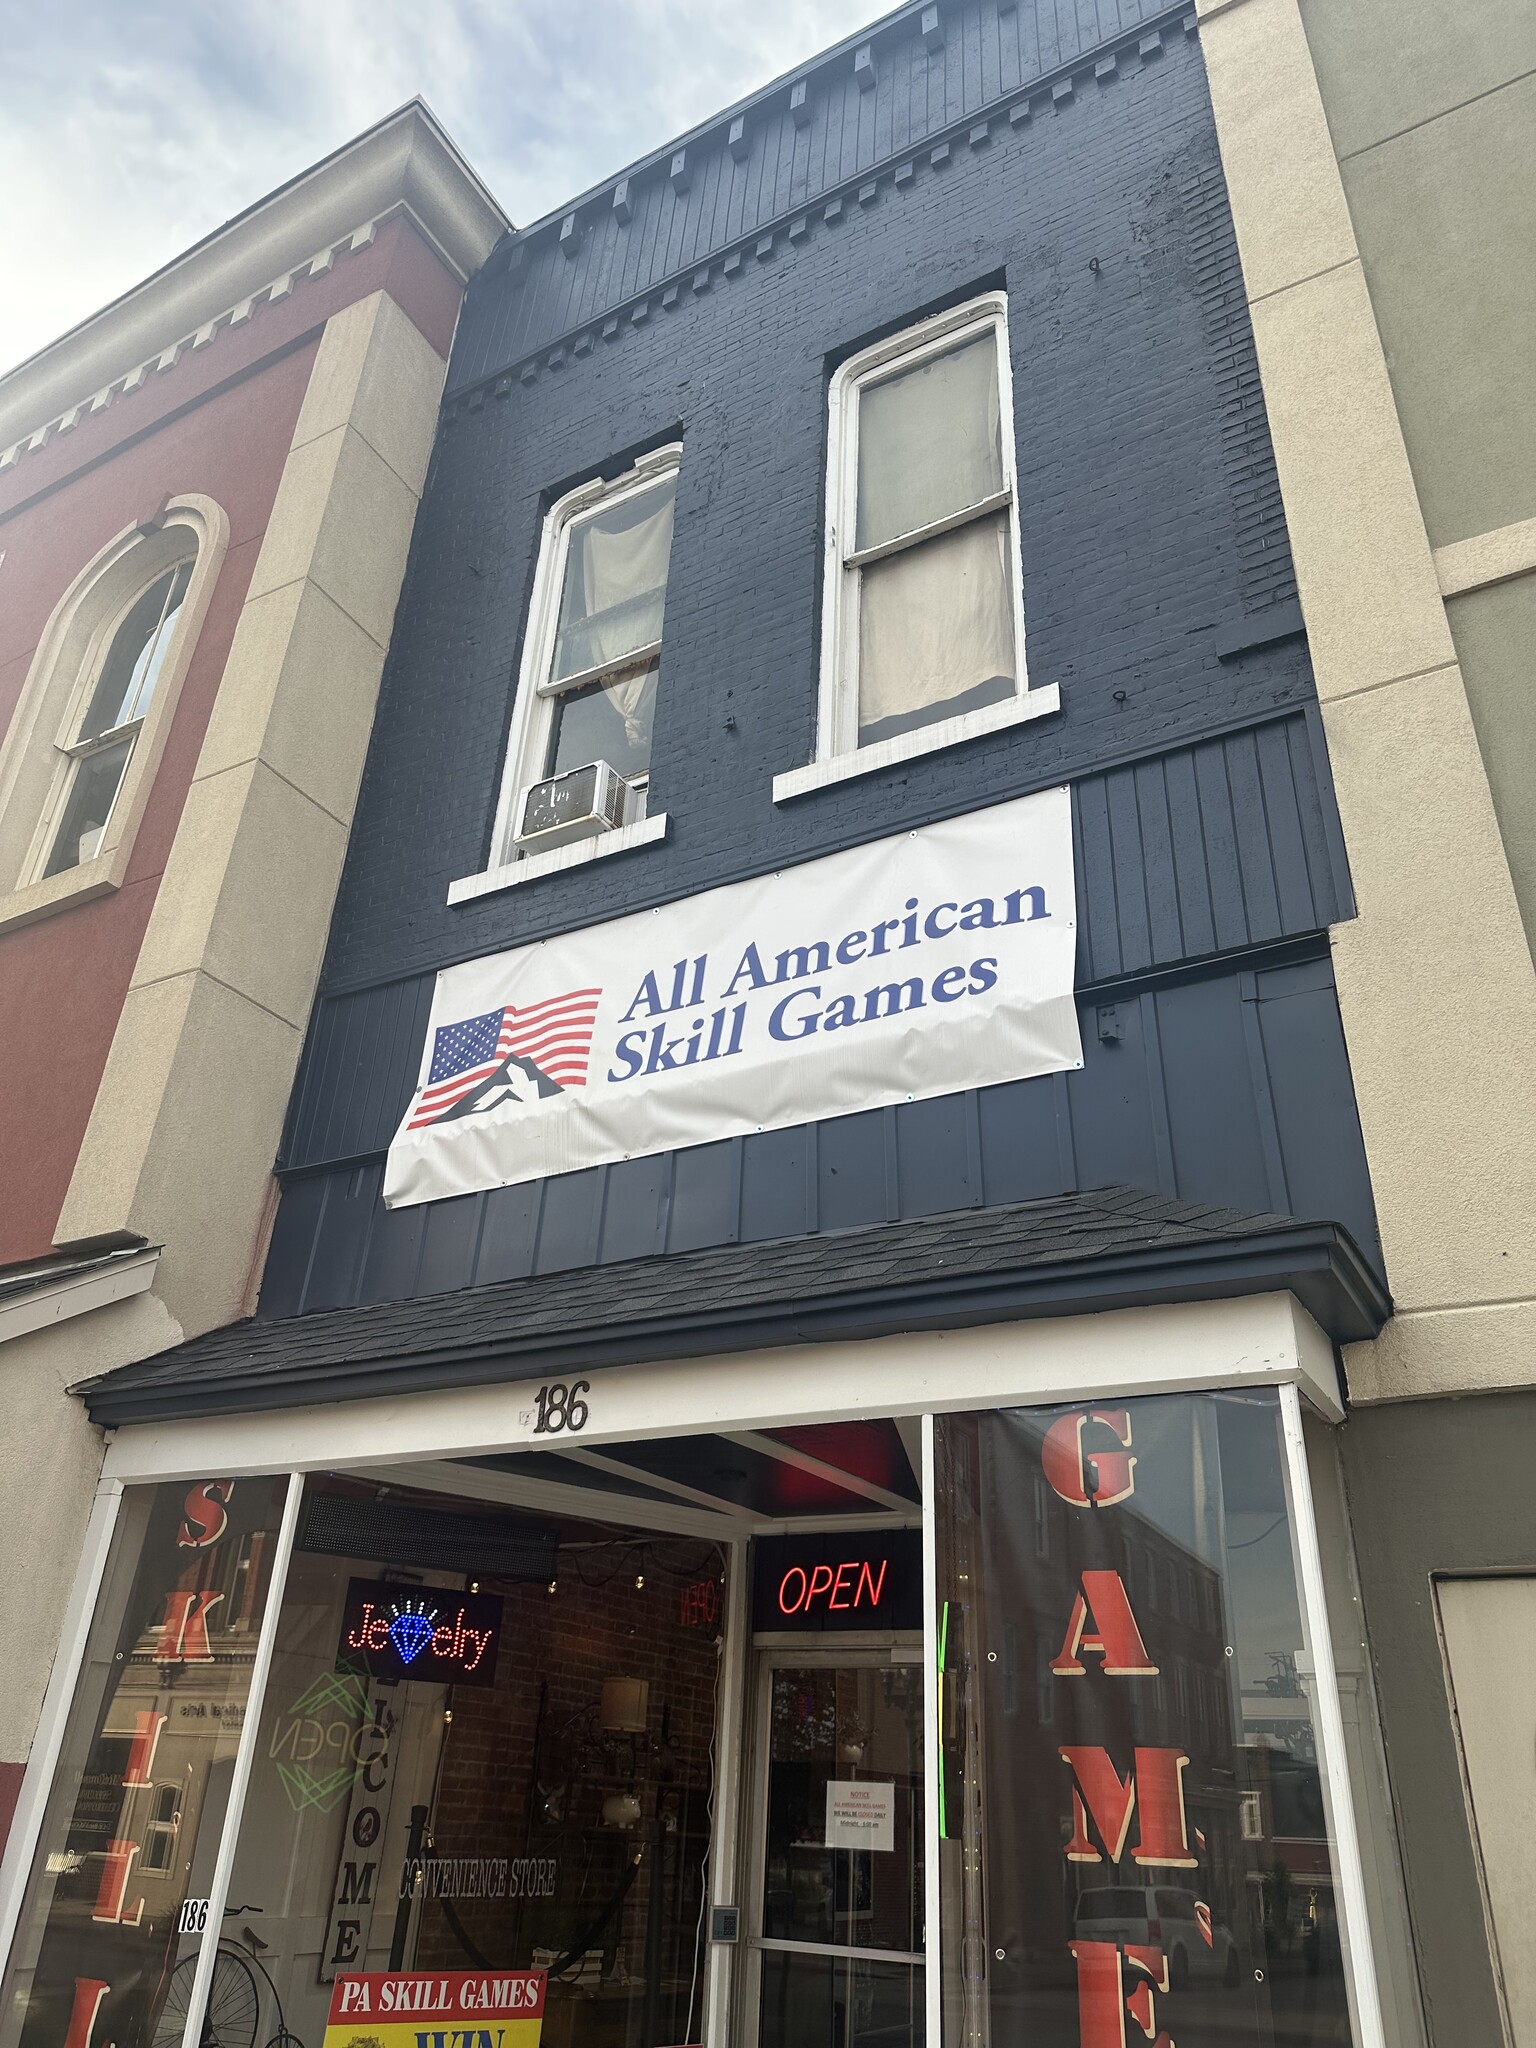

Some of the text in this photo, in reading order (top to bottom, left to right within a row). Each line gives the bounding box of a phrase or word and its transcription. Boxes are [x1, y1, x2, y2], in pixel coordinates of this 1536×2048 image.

[617, 885, 1052, 1024] All American
[607, 957, 999, 1083] Skill Games
[533, 1380, 590, 1433] 186
[779, 1560, 887, 1614] OPEN
[330, 1676, 400, 1964] LCOME
[850, 1791, 870, 1799] NOTICE
[399, 1857, 557, 1900] CONVENIENCE STORE
[181, 1900, 209, 1932] 186
[338, 1978, 539, 2013] PA SKILL GAMES
